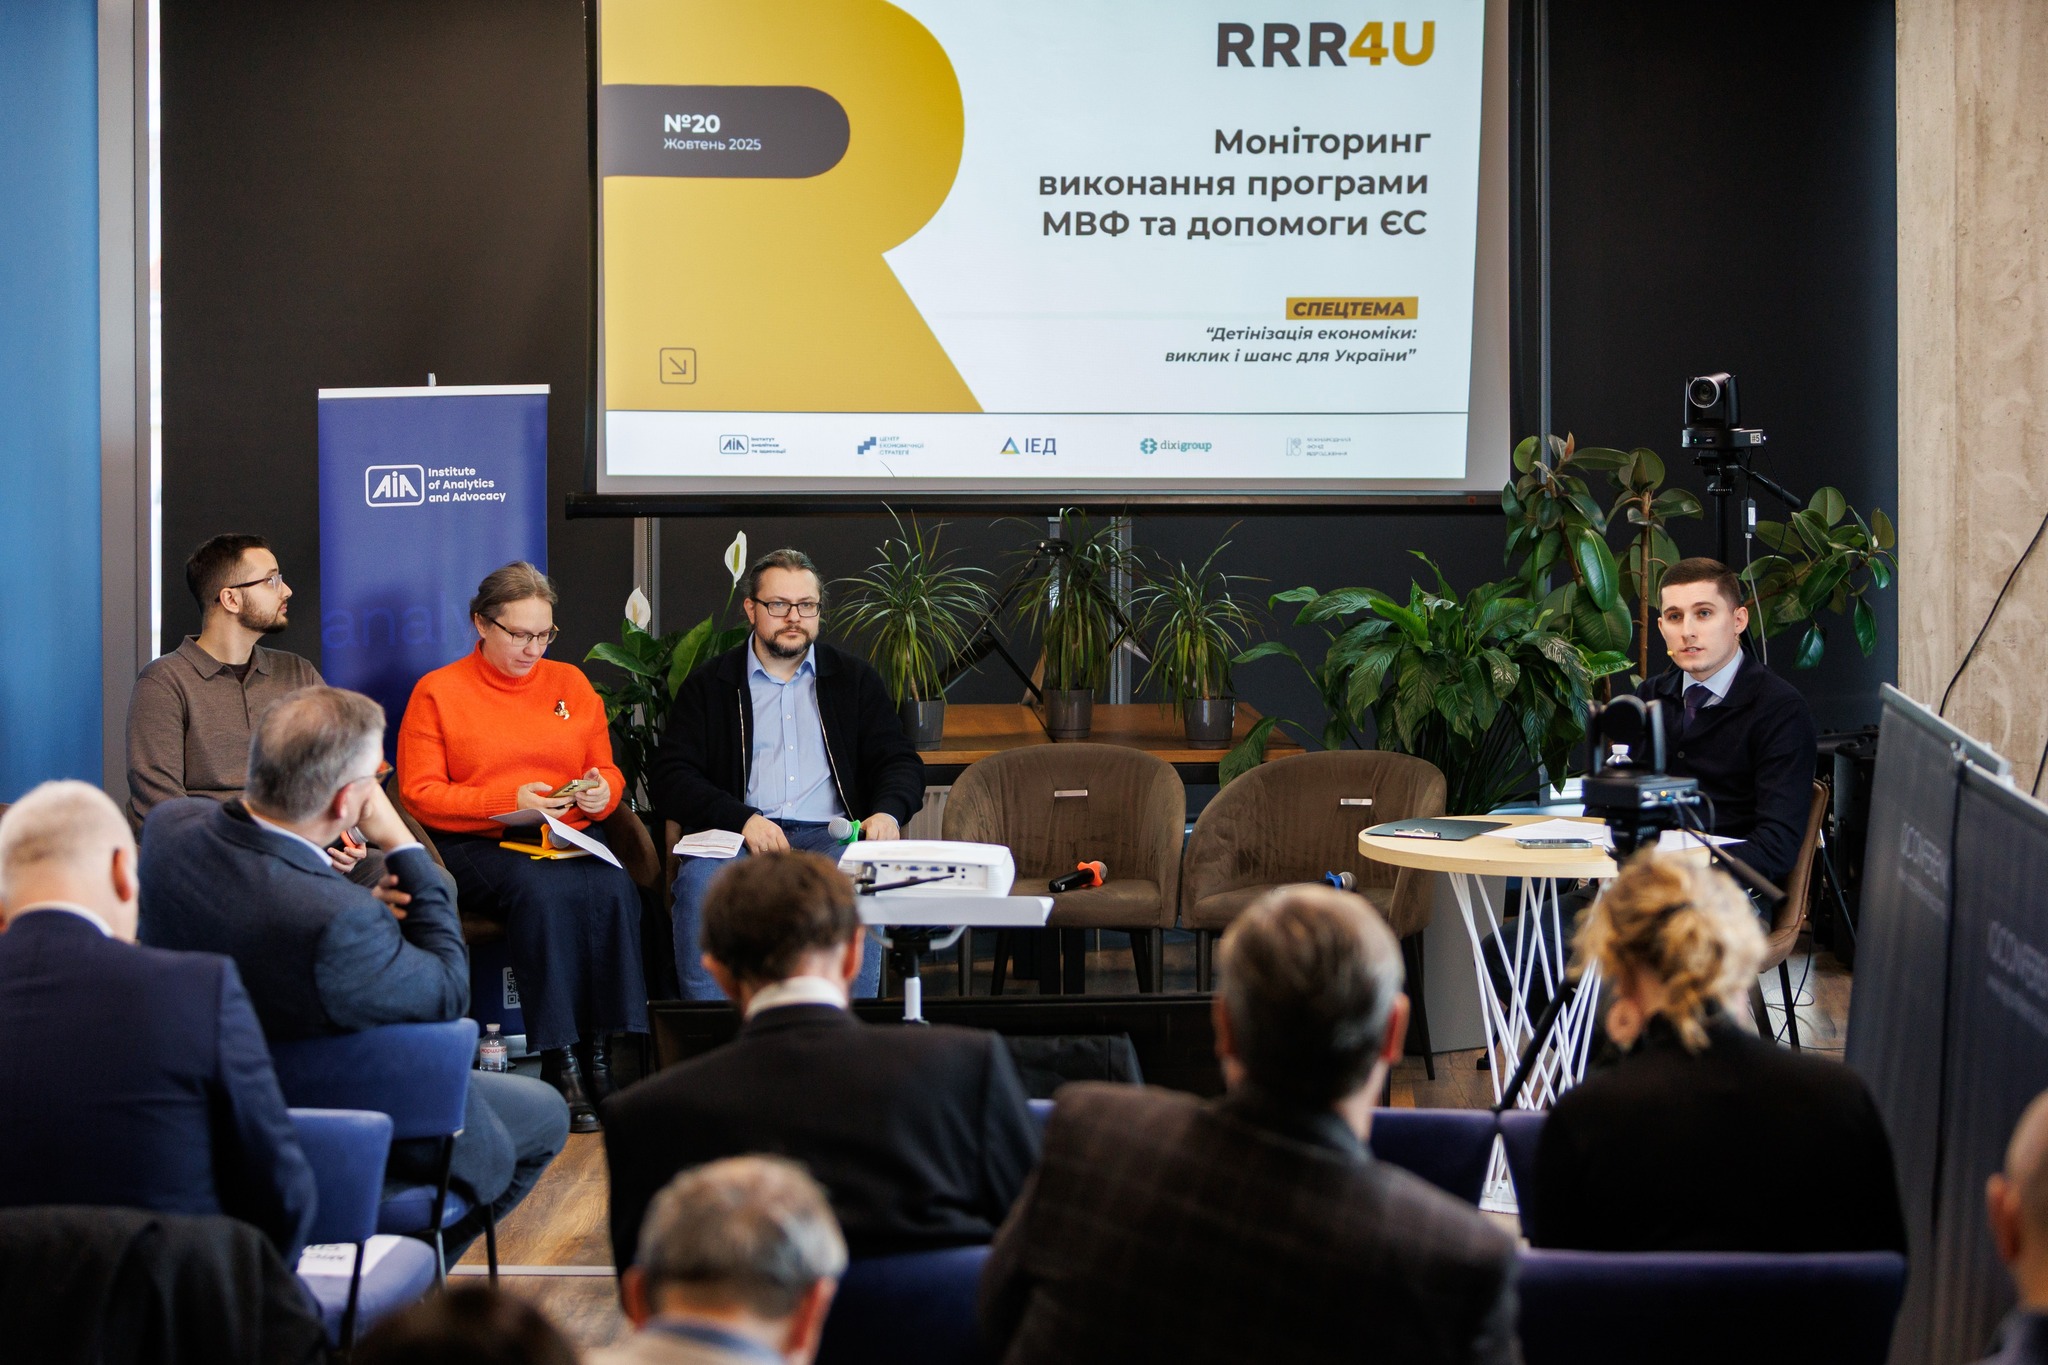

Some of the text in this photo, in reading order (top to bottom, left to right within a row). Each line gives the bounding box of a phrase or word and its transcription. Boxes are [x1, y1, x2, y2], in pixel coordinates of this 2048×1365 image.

[1217, 20, 1436, 68] RRR4U
[664, 114, 721, 134] №20
[664, 138, 762, 151] Жовтень 2025
[1214, 126, 1431, 160] Моніторинг
[1039, 174, 1428, 202] виконання програми
[1042, 209, 1428, 240] МВФ та допомоги ЄС
[1293, 301, 1406, 319] СПЕЦТЕМА
[1206, 325, 1417, 342] “Детінізація економіки:
[1165, 348, 1417, 365] виклик і шанс для України”
[1160, 440, 1213, 453] dixigroup
[1751, 433, 1761, 443] #5
[428, 466, 476, 477] Institute
[428, 478, 495, 491] of Analytics
[428, 492, 507, 503] and Advocacy
